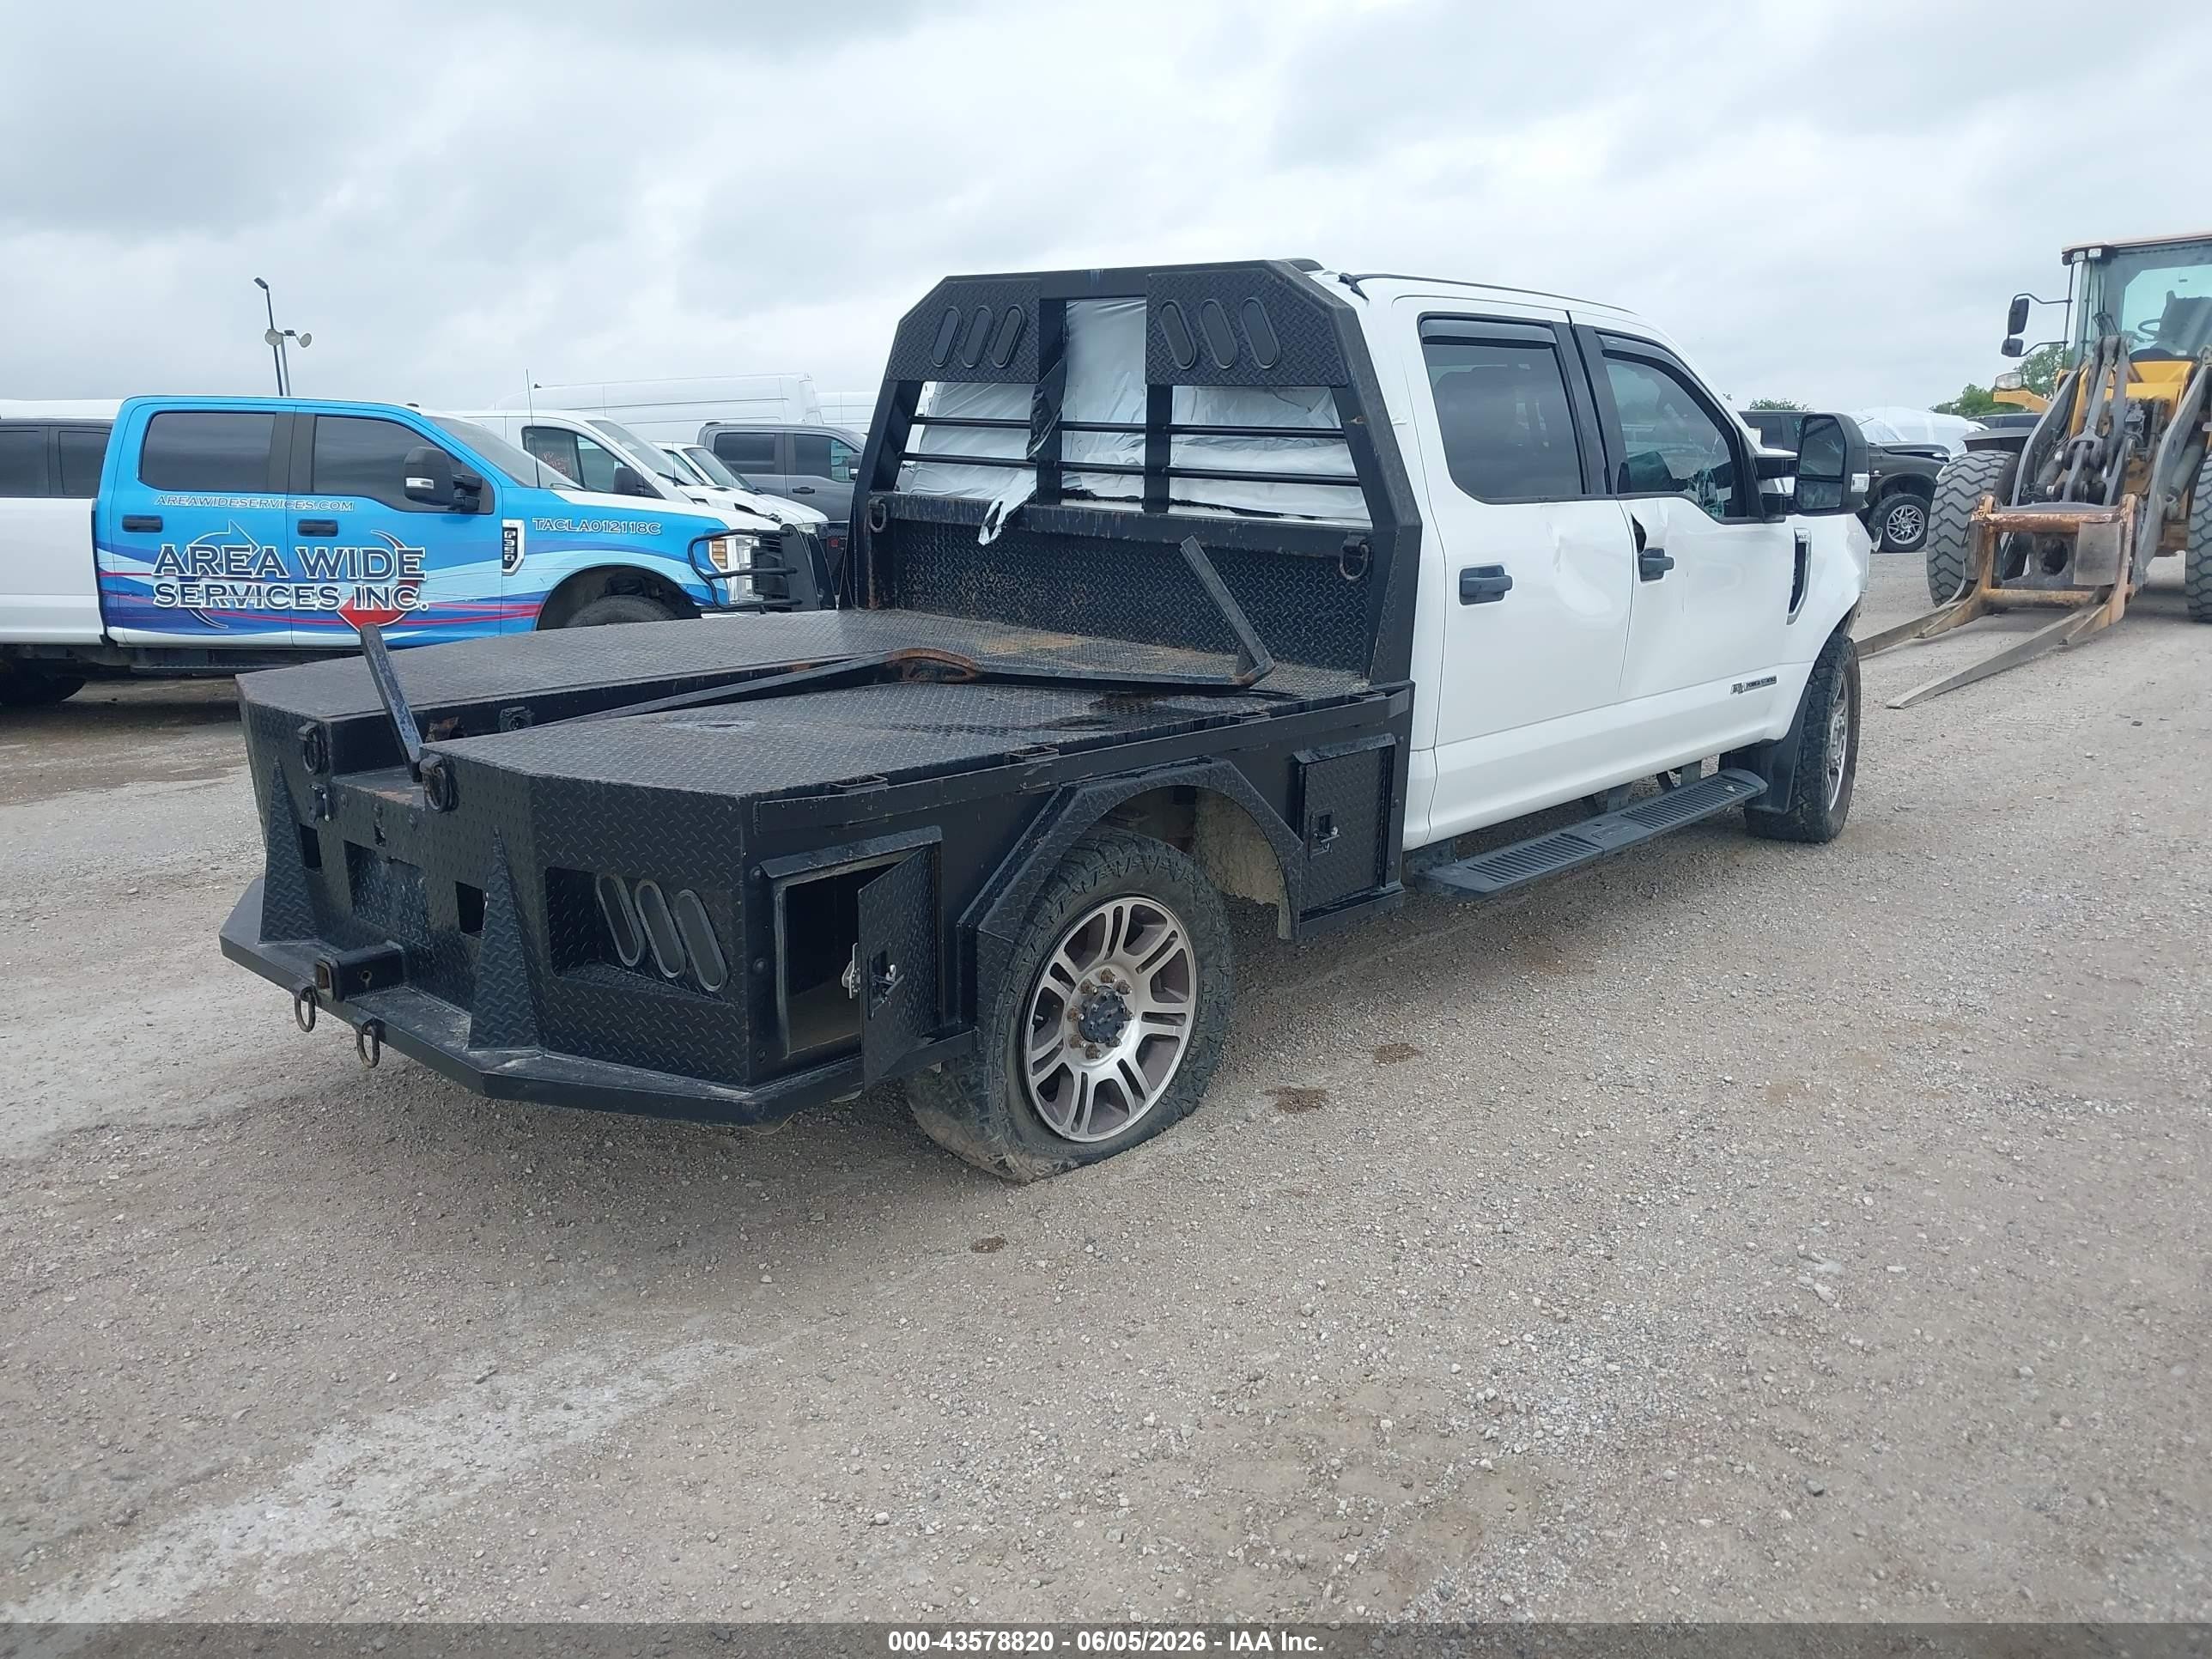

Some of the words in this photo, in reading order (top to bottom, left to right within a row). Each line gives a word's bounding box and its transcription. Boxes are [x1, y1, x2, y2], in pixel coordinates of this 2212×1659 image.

[156, 495, 354, 512] AREAWIDESERVICES.COM
[532, 517, 661, 535] TACLA012118C
[152, 544, 290, 579] AREA
[295, 547, 427, 580] WIDE
[153, 582, 339, 611] SERVICES
[353, 585, 429, 611] INC.
